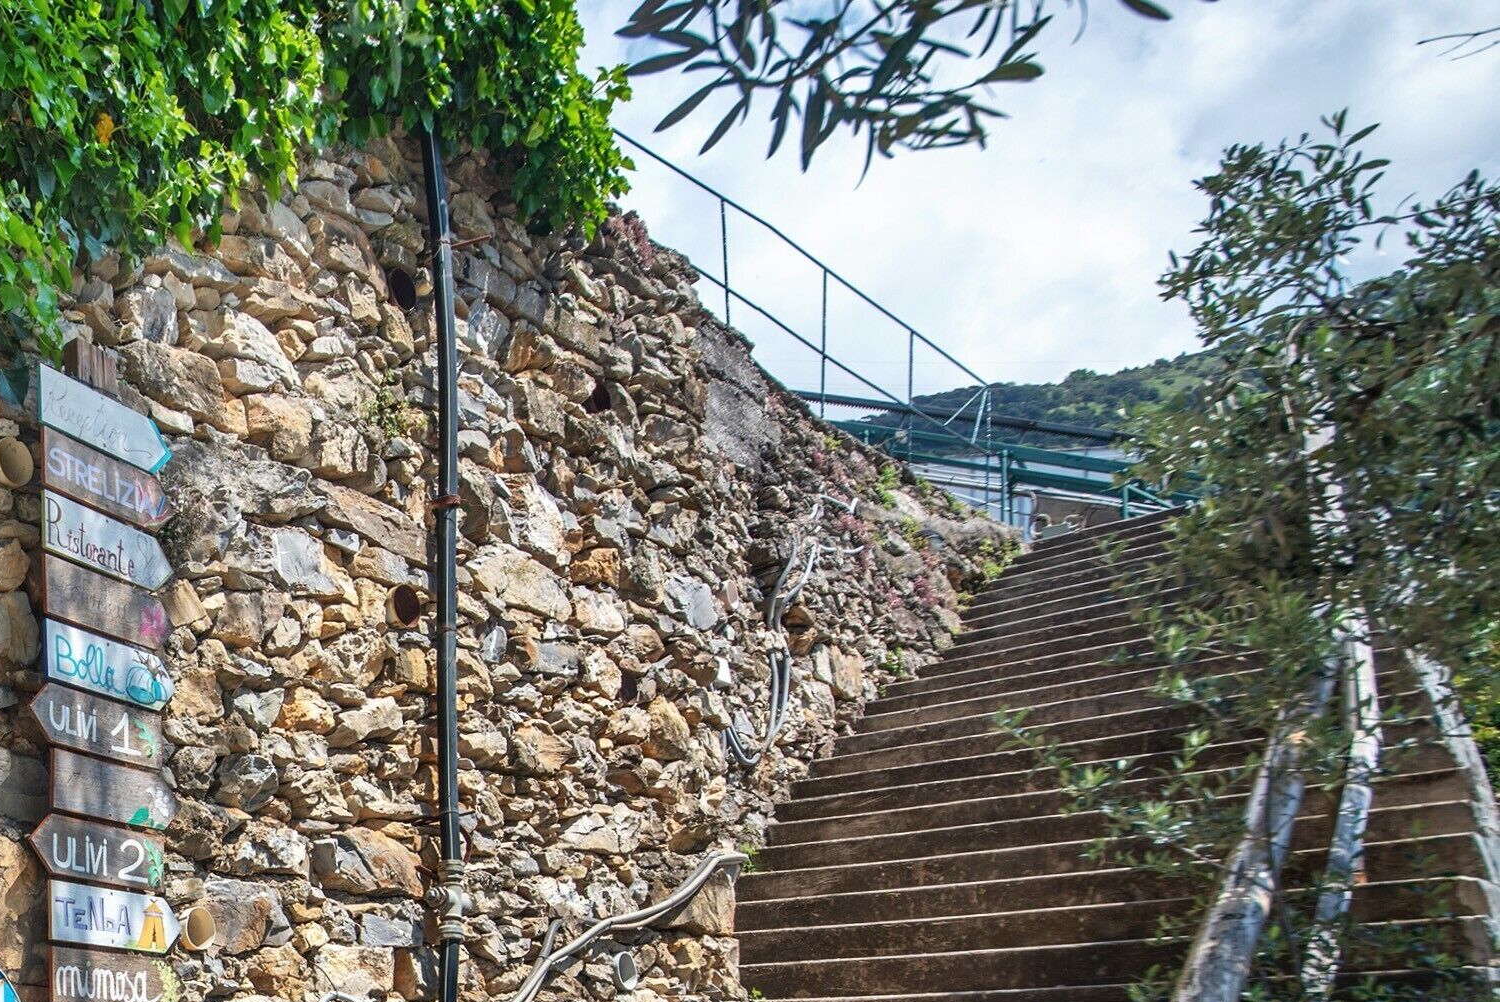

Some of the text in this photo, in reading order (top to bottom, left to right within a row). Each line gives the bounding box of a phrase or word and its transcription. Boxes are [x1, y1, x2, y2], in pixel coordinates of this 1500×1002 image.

[47, 496, 135, 577] Ristorante
[55, 634, 126, 695] Bolla
[111, 711, 142, 757] 1
[117, 838, 149, 884] 2
